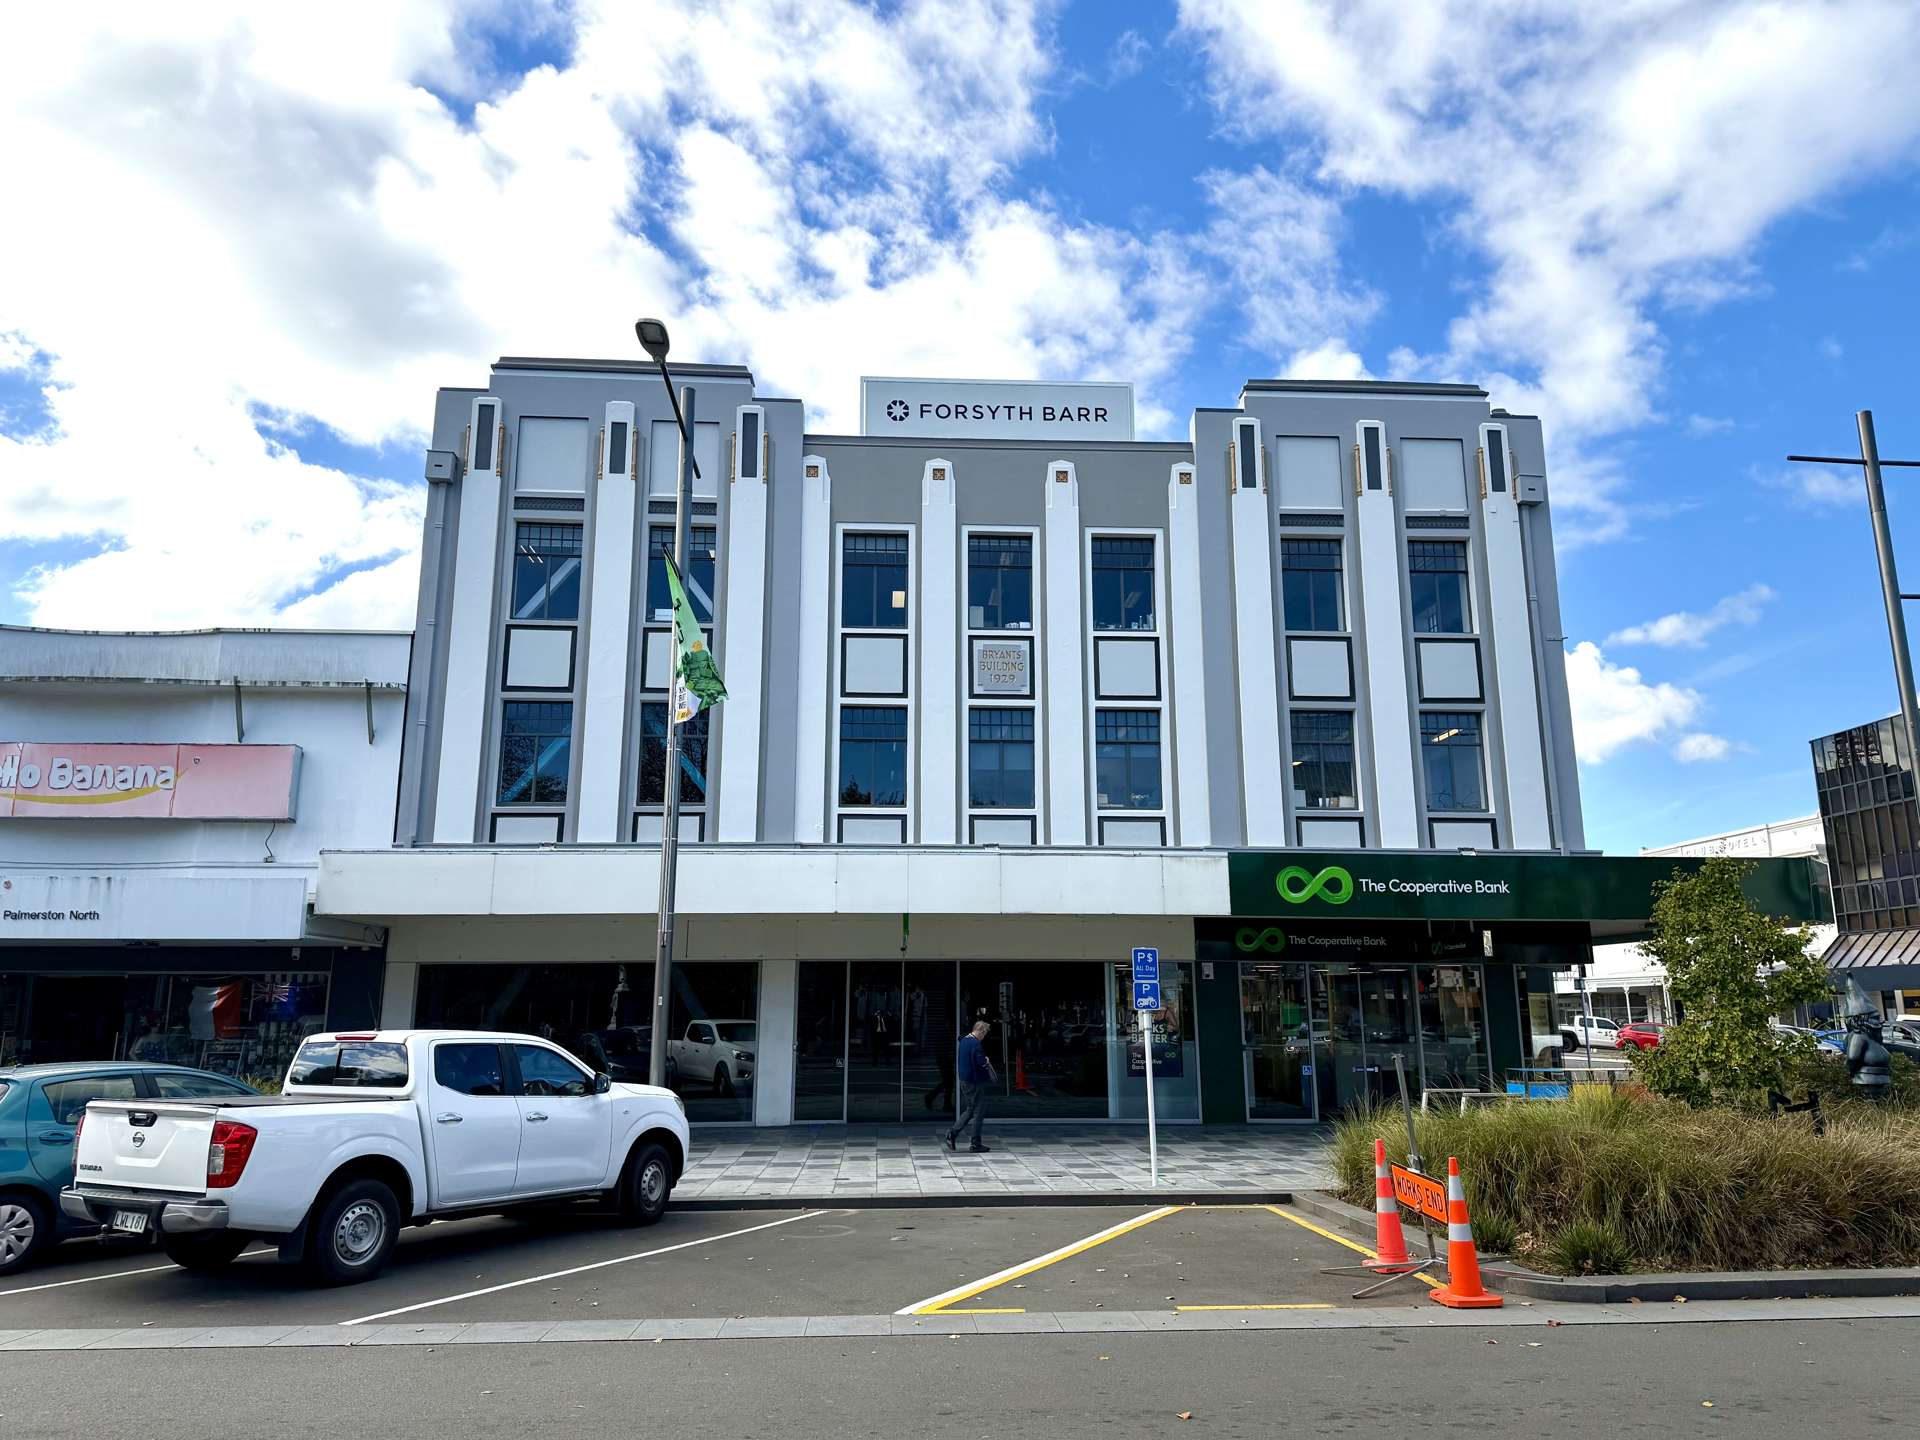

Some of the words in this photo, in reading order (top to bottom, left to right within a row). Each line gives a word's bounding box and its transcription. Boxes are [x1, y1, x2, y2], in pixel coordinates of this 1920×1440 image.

[919, 403, 1033, 421] FORSYTH
[1042, 406, 1109, 422] BARR
[979, 661, 1025, 671] BUILDING
[48, 757, 176, 791] Banana
[1359, 879, 1386, 892] The
[1388, 879, 1473, 896] Cooperative
[1474, 880, 1510, 894] Bank
[3, 910, 65, 921] Palmerston
[69, 910, 100, 921] North
[1288, 935, 1306, 945] The
[1307, 935, 1362, 948] Cooperative
[1363, 936, 1387, 946] Bank
[1142, 984, 1150, 994] P
[1394, 1174, 1422, 1202] WORKS
[1425, 1187, 1443, 1212] END
